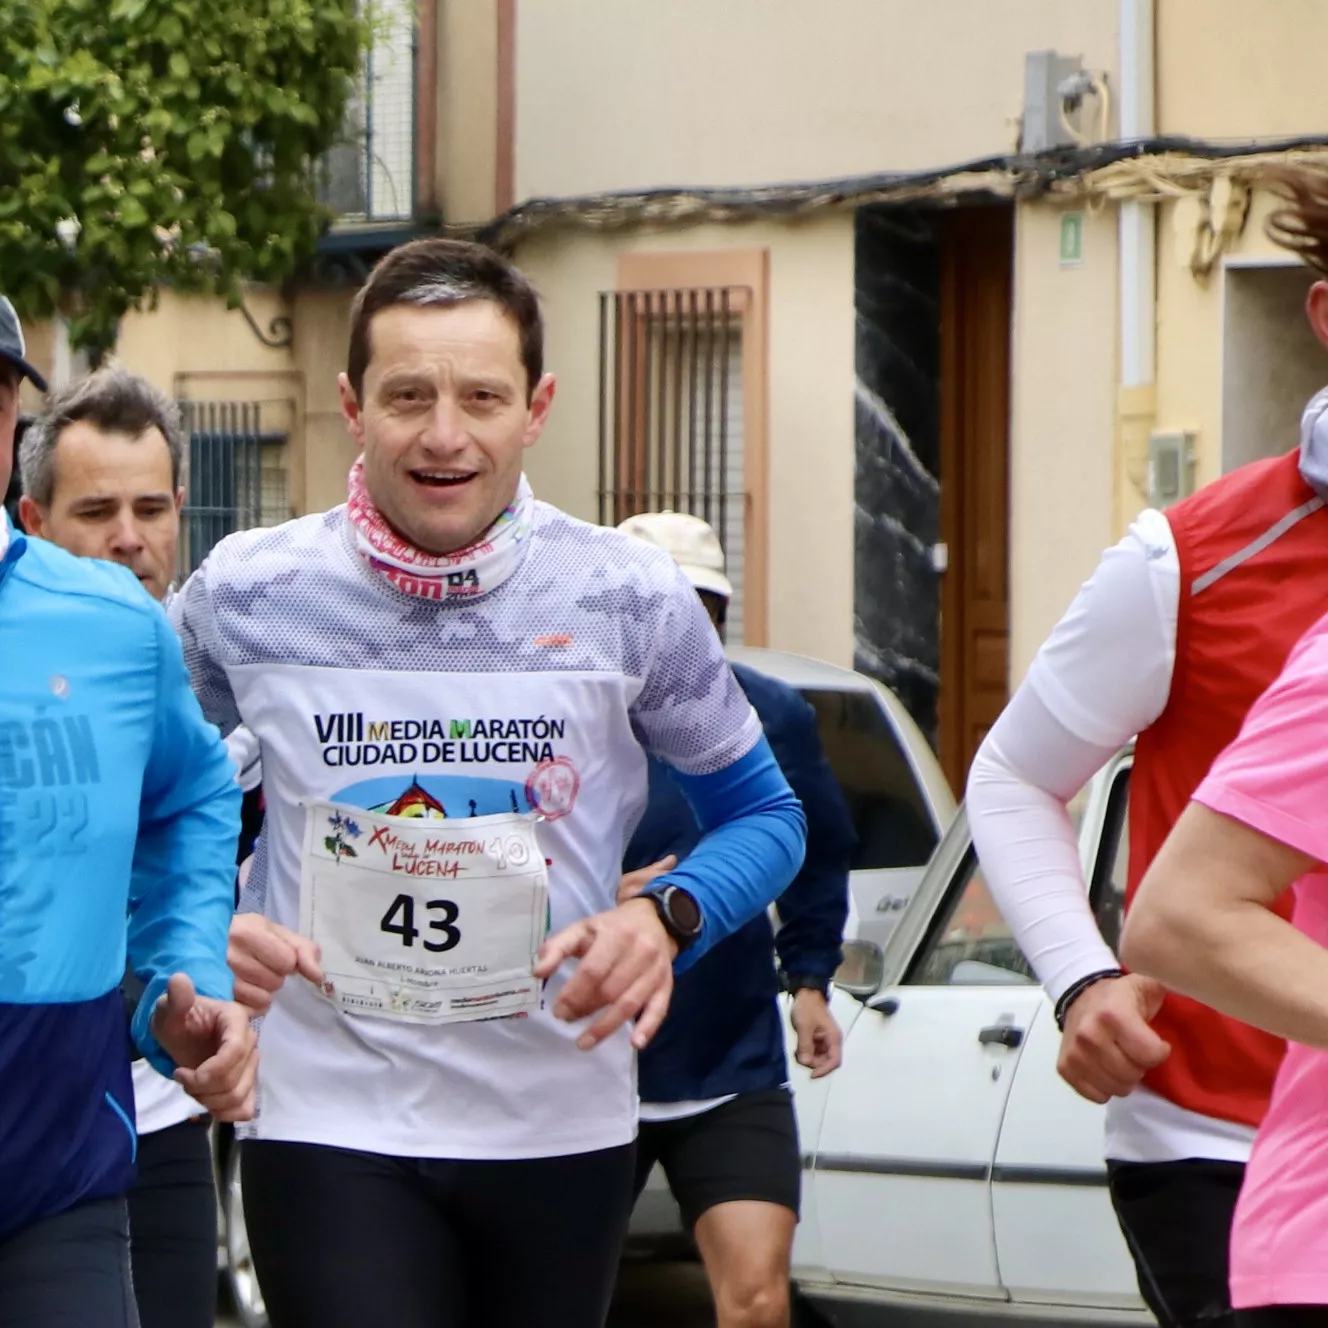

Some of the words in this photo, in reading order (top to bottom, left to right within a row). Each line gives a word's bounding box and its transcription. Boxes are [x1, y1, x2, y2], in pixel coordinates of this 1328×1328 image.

[314, 713, 363, 743] VIII
[367, 720, 444, 742] MEDIA
[449, 715, 565, 740] MARATÓN
[323, 743, 417, 767] CIUDAD
[423, 742, 456, 763] DE
[461, 741, 554, 763] LUCENA
[392, 853, 469, 880] LUCENA
[380, 893, 461, 952] 43
